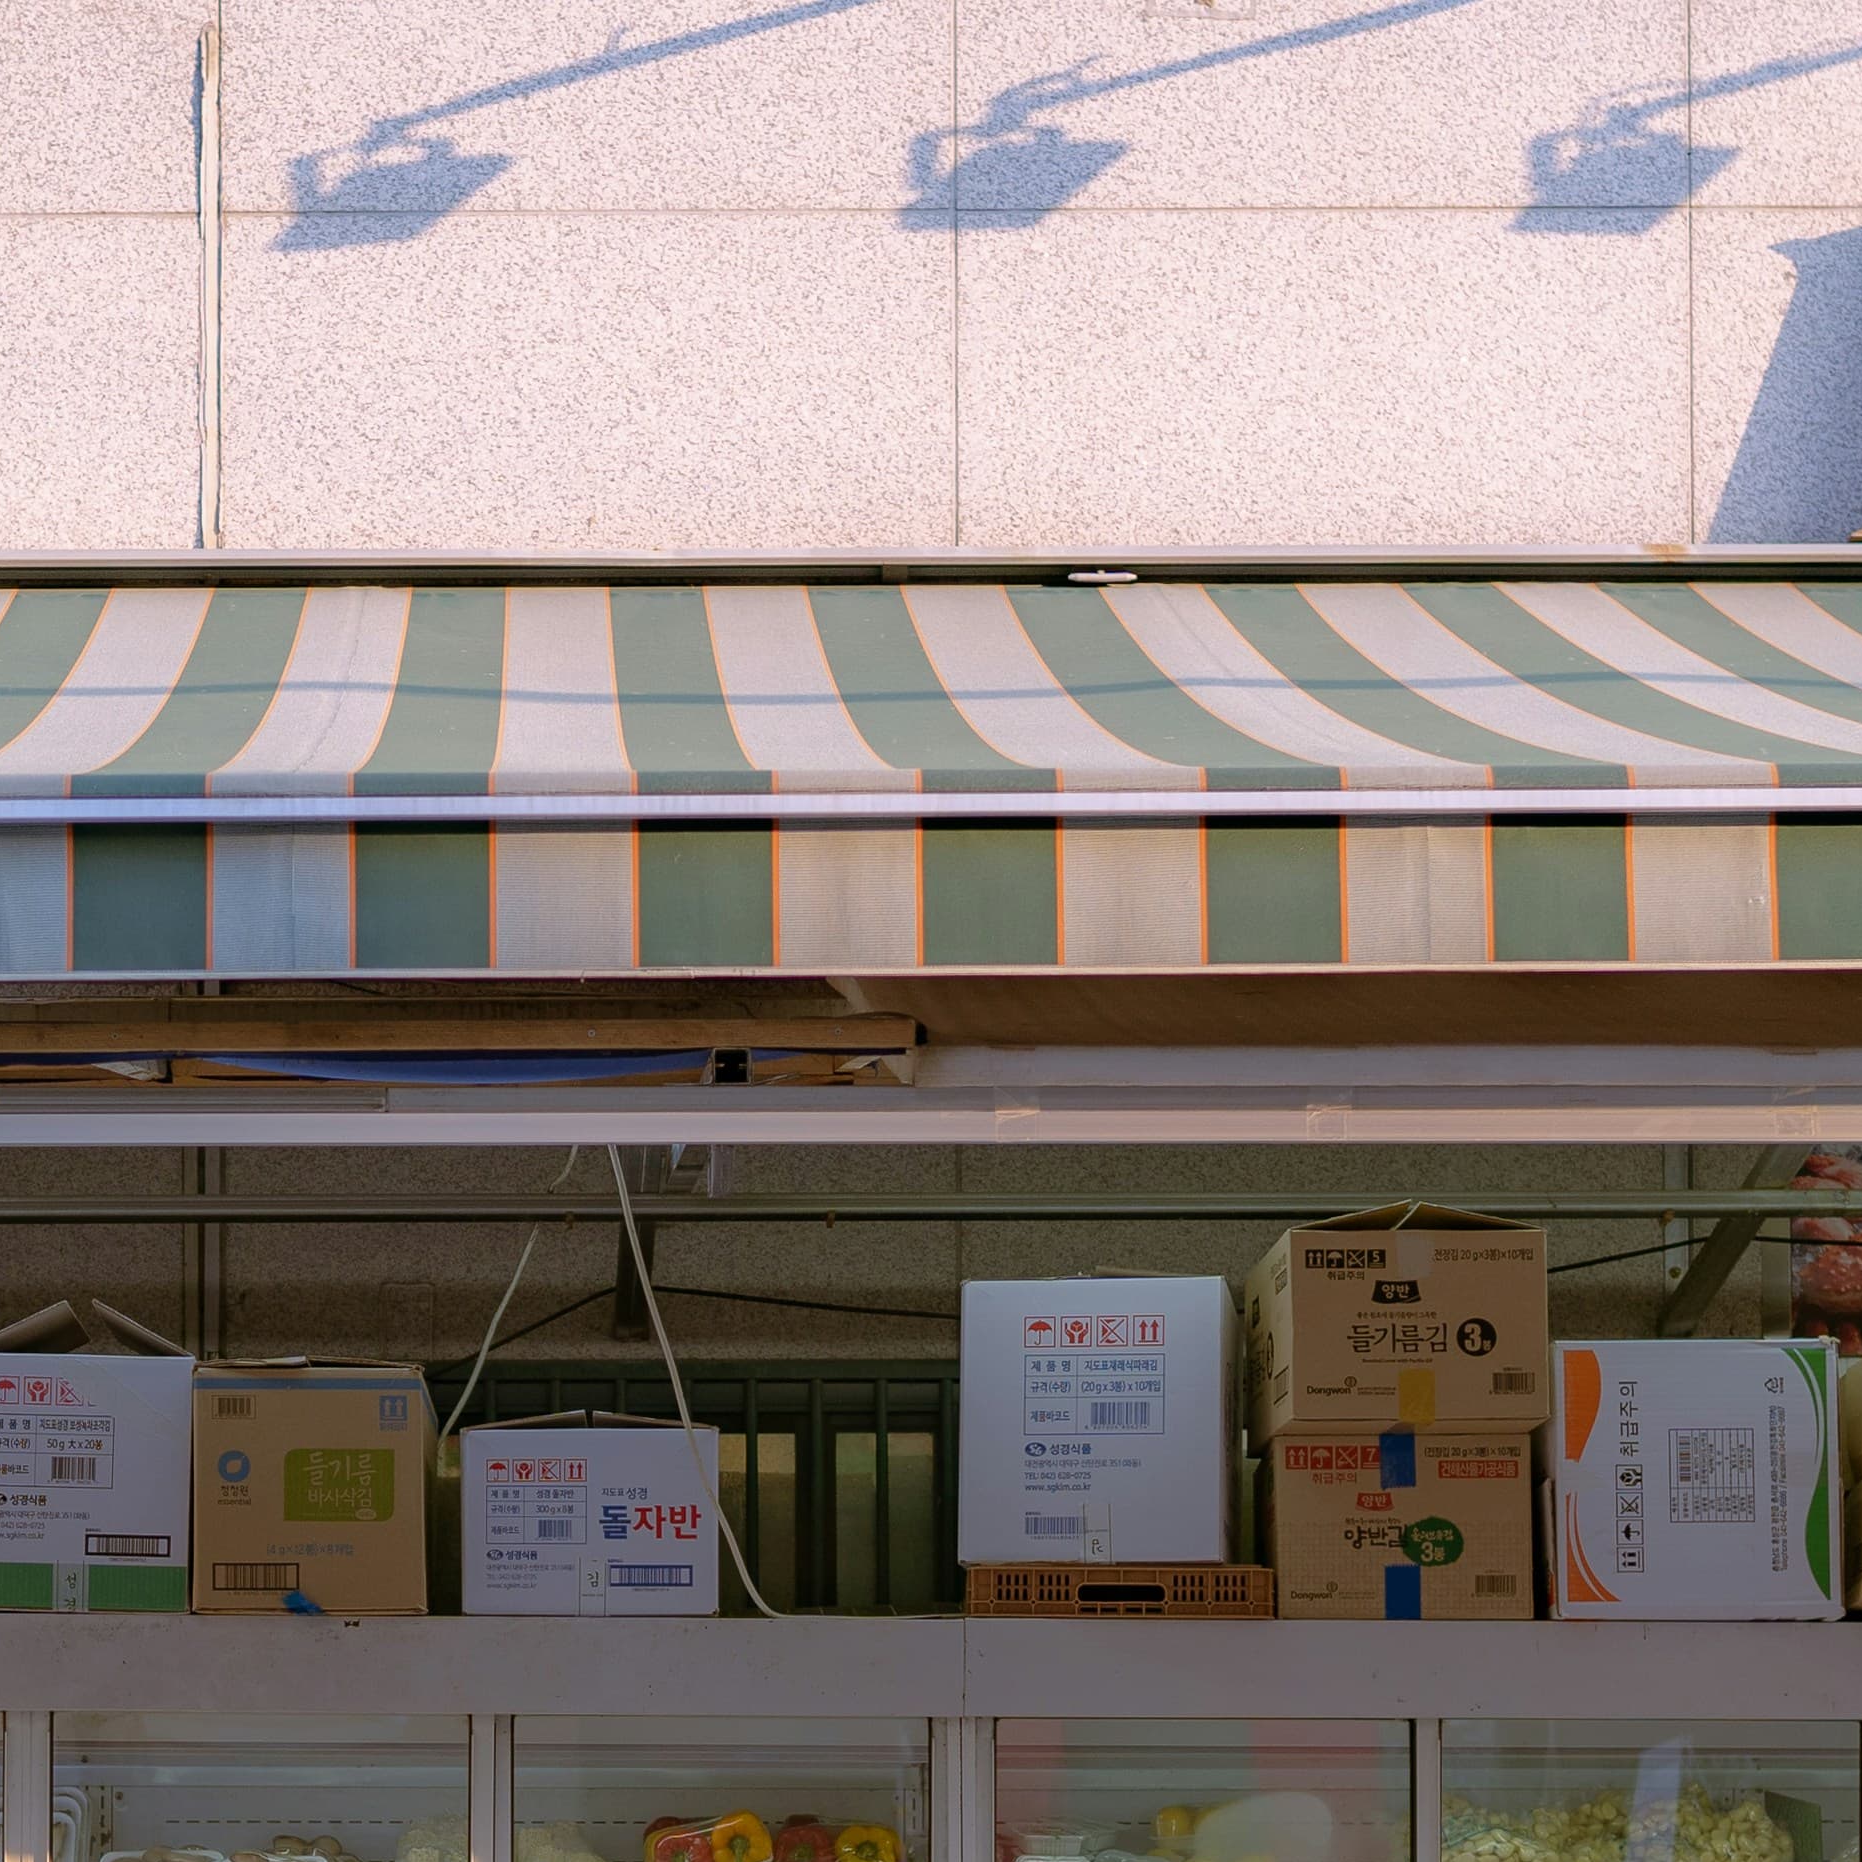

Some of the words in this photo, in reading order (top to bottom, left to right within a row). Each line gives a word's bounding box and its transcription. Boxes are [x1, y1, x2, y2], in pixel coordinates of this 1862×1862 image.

[1381, 1283, 1410, 1299] 양반
[1347, 1322, 1449, 1354] 들기름김
[1306, 1385, 1352, 1398] Dongwon
[1049, 1443, 1092, 1455] 성경식품
[303, 1451, 378, 1487] 들기름
[9, 1494, 47, 1506] 성경식품
[626, 1487, 647, 1500] 성경
[1361, 1494, 1388, 1508] 양반
[599, 1504, 702, 1540] 돌자반
[505, 1551, 538, 1562] 성경식품
[1290, 1590, 1333, 1603] Dongwon
